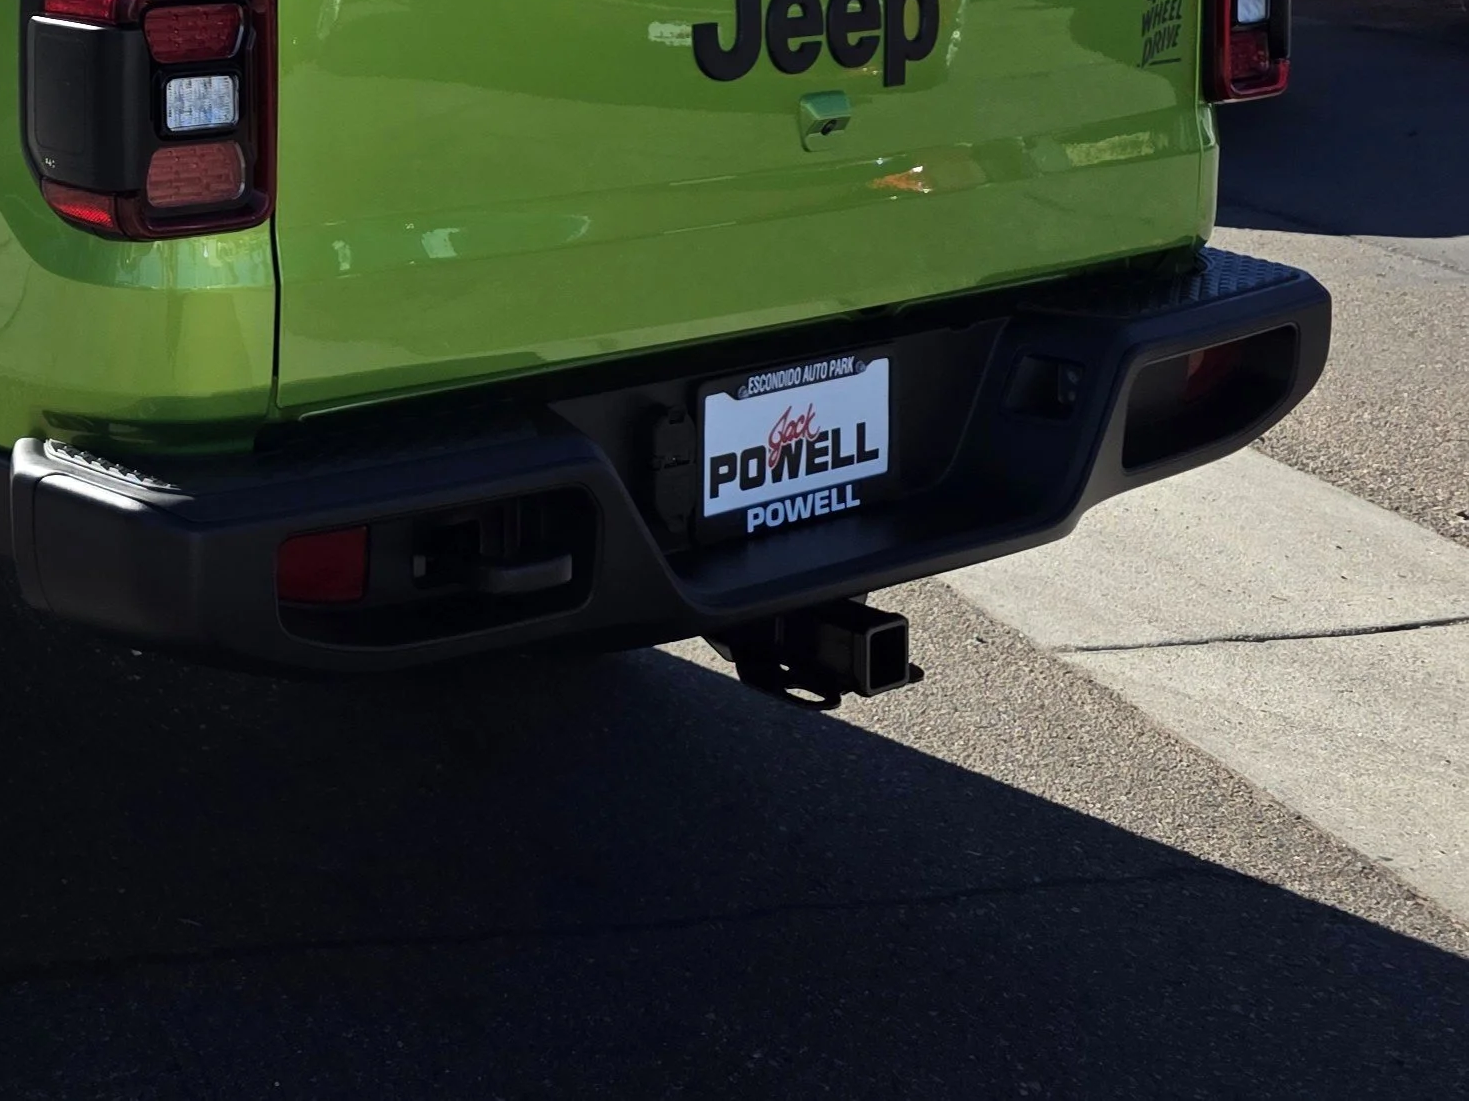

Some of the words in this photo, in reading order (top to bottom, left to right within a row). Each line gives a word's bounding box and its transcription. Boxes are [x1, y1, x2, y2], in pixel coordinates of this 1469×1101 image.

[1140, 24, 1181, 69] DRIVE
[748, 370, 801, 395] ESCONDIDO
[803, 363, 828, 383] AUTO
[829, 355, 856, 377] PARK
[709, 421, 880, 499] POWELL
[768, 403, 820, 469] Jack
[747, 484, 861, 533] POWELL
